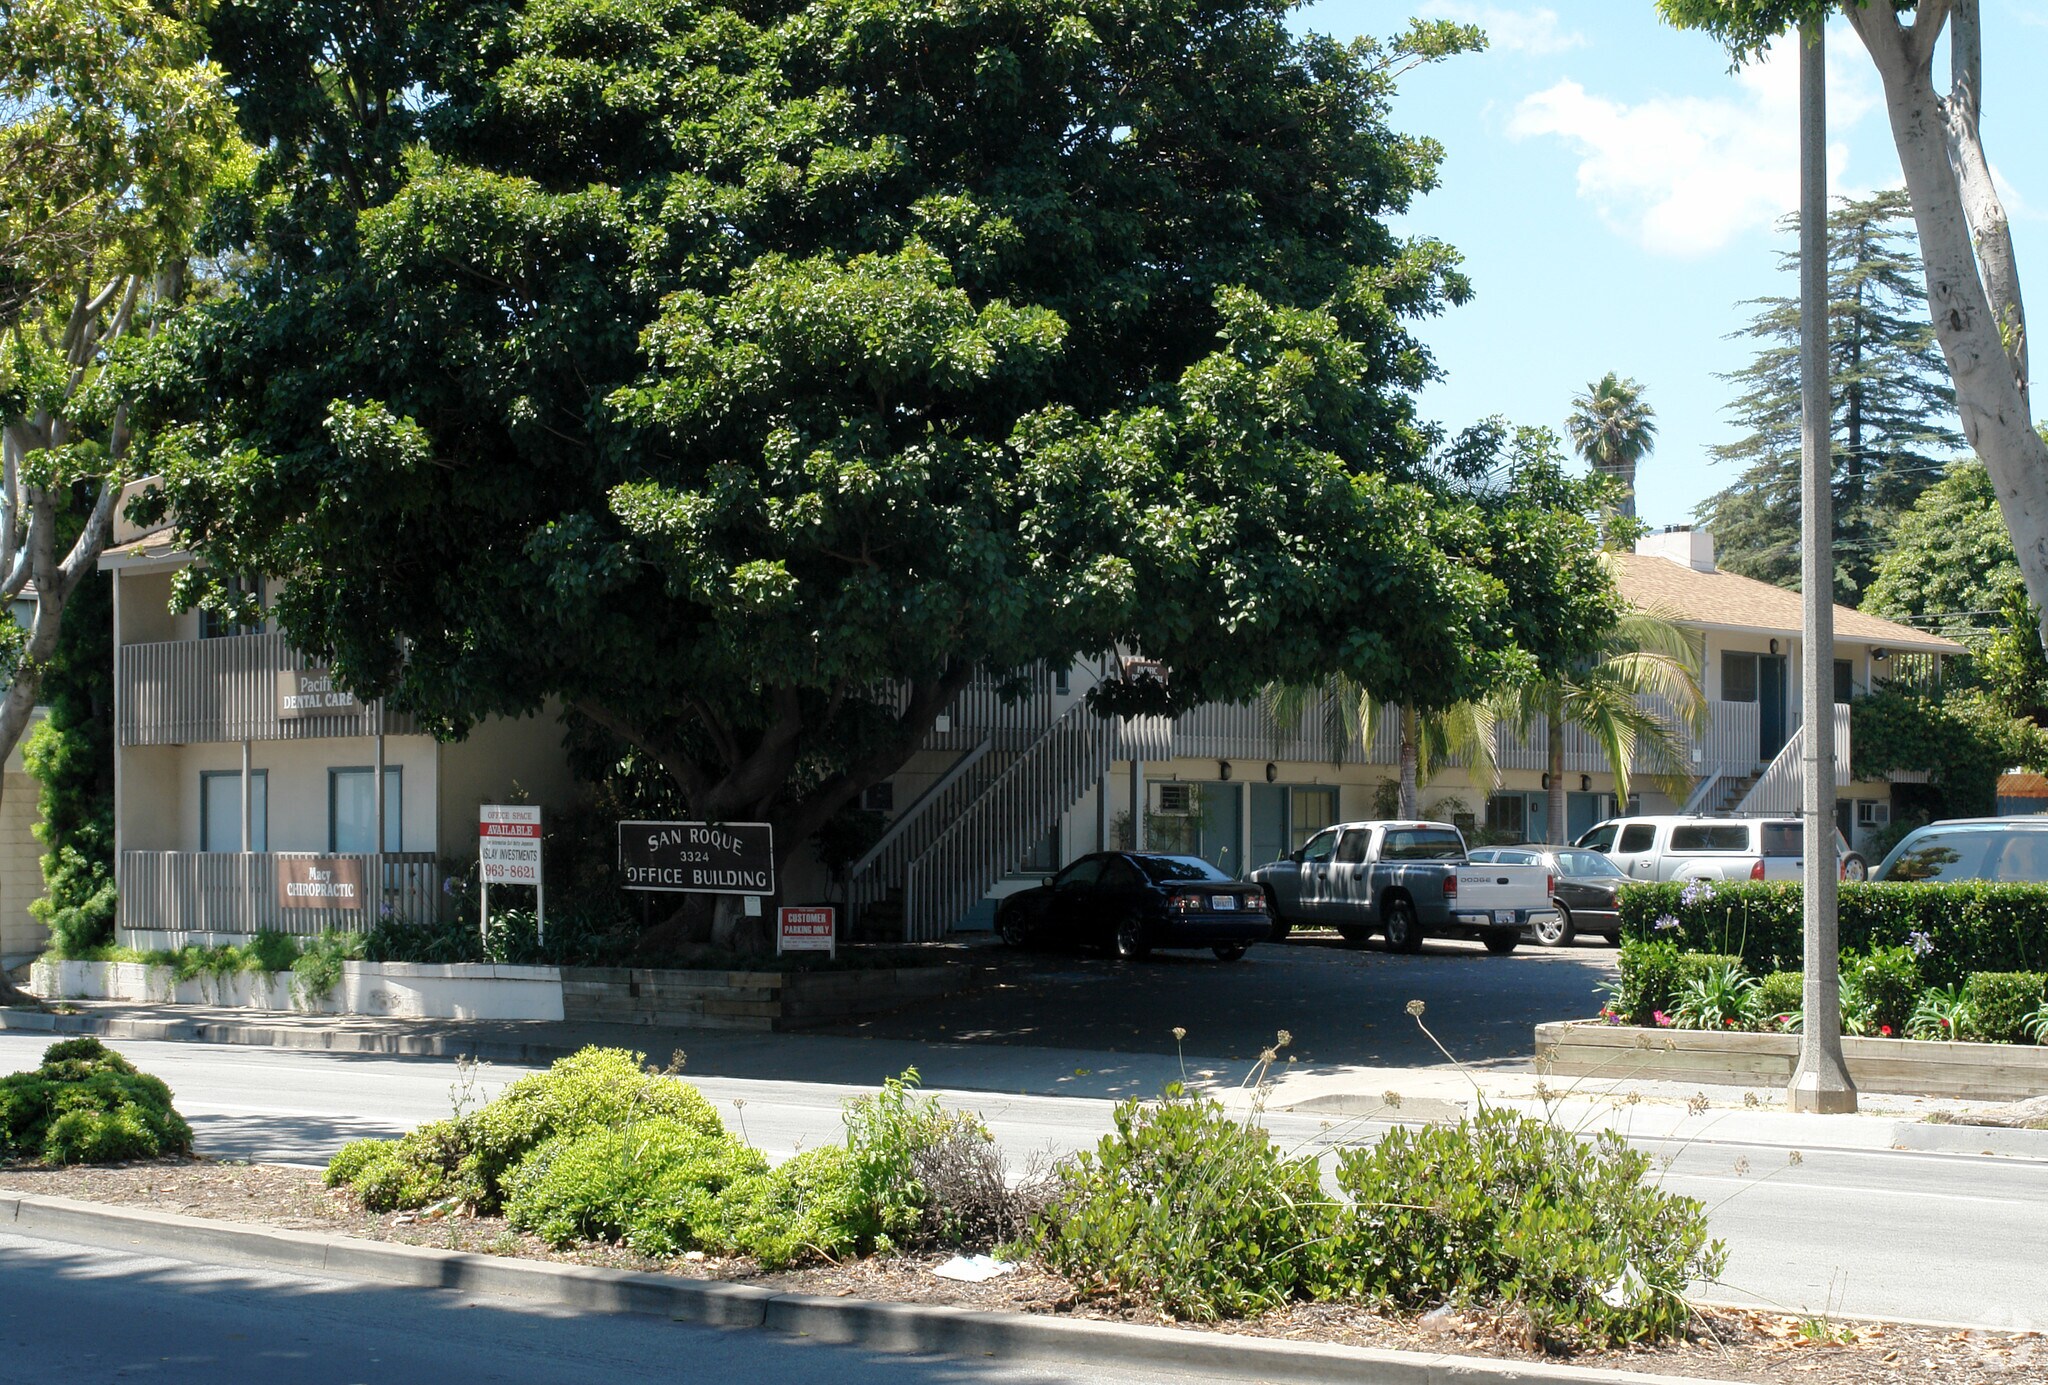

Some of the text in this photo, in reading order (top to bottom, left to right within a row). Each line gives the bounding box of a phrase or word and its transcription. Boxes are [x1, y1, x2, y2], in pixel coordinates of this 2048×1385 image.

[301, 675, 333, 693] Pacifi
[283, 692, 353, 709] DENTAL CARE
[512, 812, 533, 820] SPACE
[487, 825, 533, 836] AVAILABLE
[647, 828, 744, 857] SAN ROQUE
[500, 849, 538, 861] INVESTMENTS
[680, 851, 710, 862] 3324
[308, 867, 331, 883] Macy
[485, 864, 535, 879] 963-8621
[628, 867, 767, 888] OFFICE BUILDING
[286, 883, 354, 897] CHIROPRACTIC
[787, 913, 827, 923] CUSTOMER
[784, 925, 830, 934] PARKING ONLY
